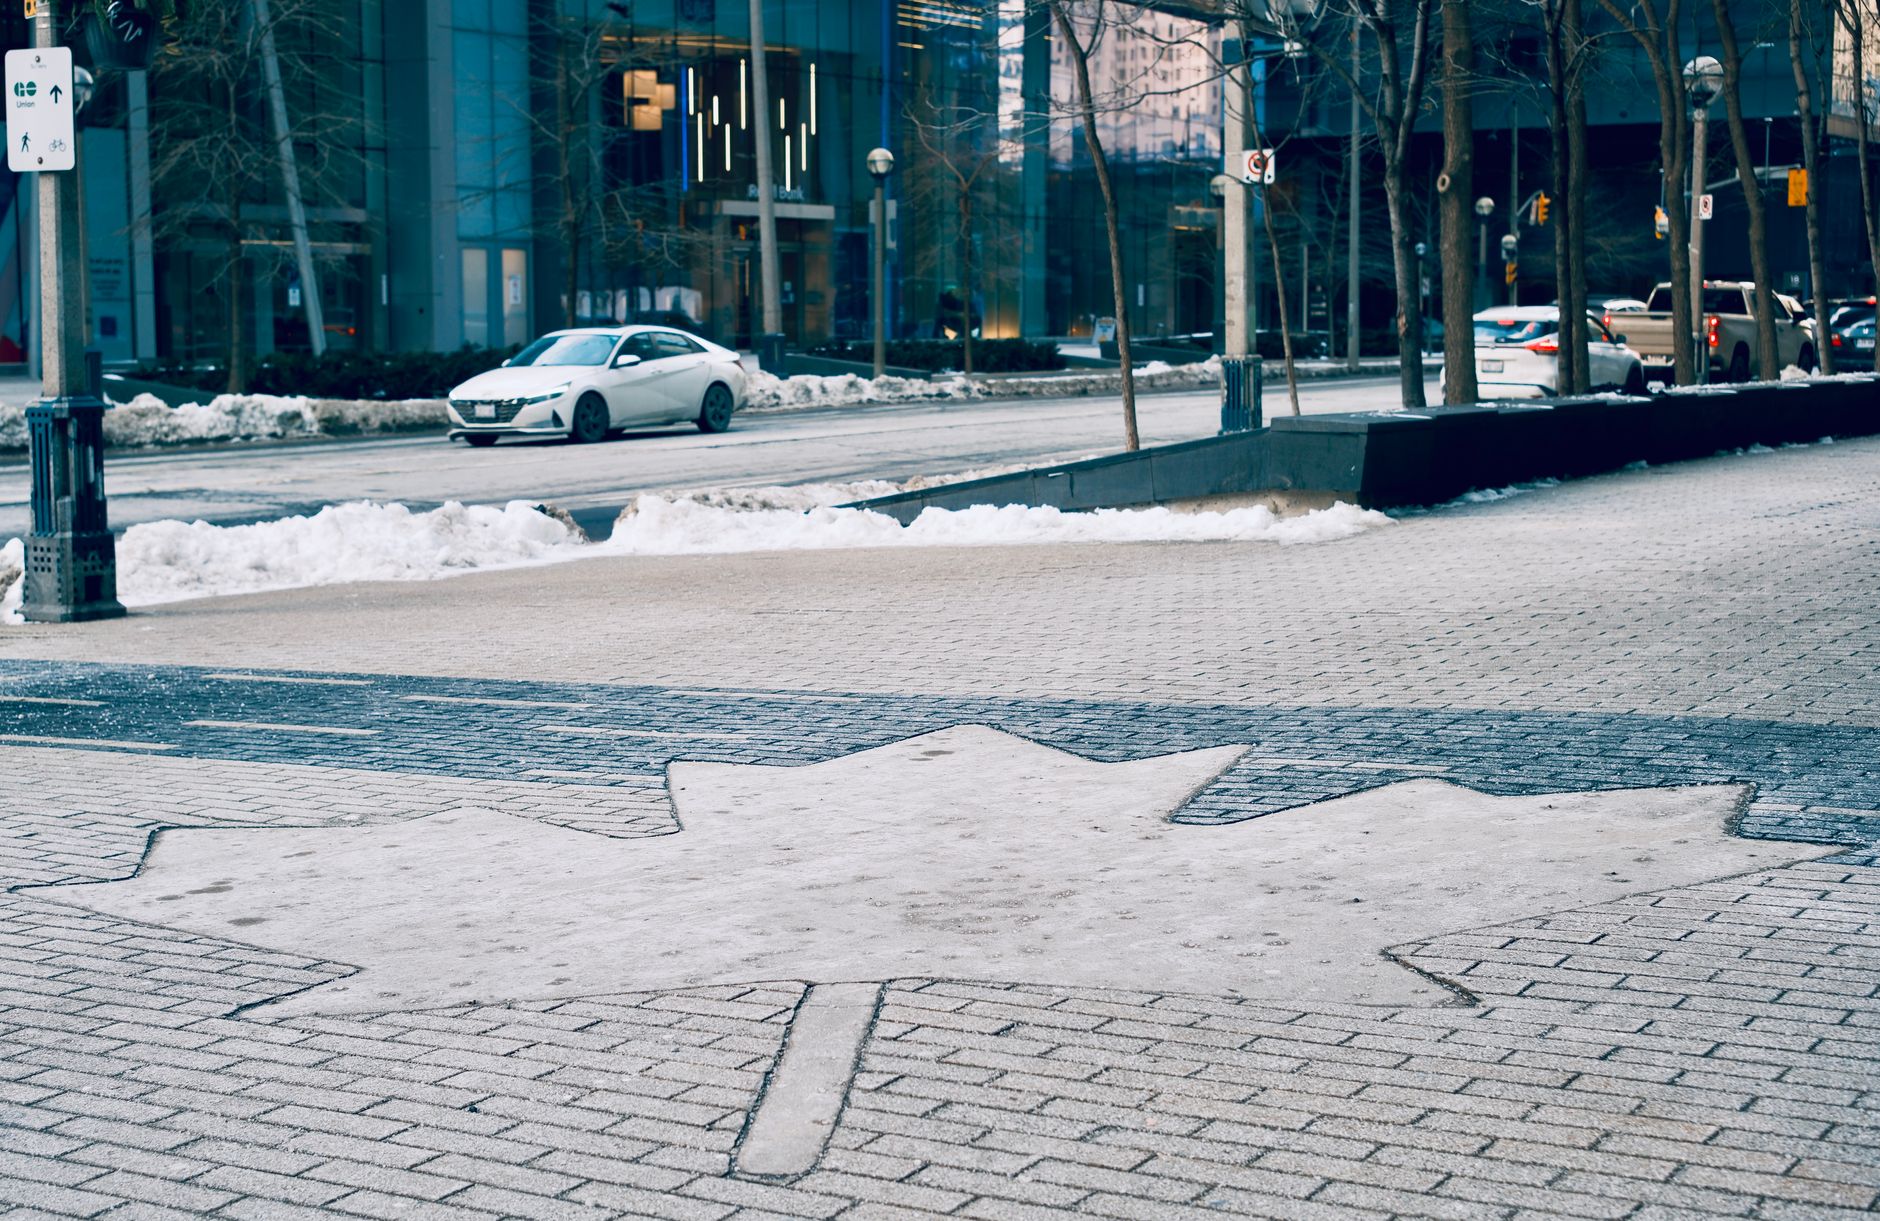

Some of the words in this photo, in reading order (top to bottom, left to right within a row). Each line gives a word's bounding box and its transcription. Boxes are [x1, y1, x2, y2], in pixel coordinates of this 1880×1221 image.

[14, 81, 37, 97] GO
[16, 100, 35, 109] Union
[779, 184, 804, 200] Bank
